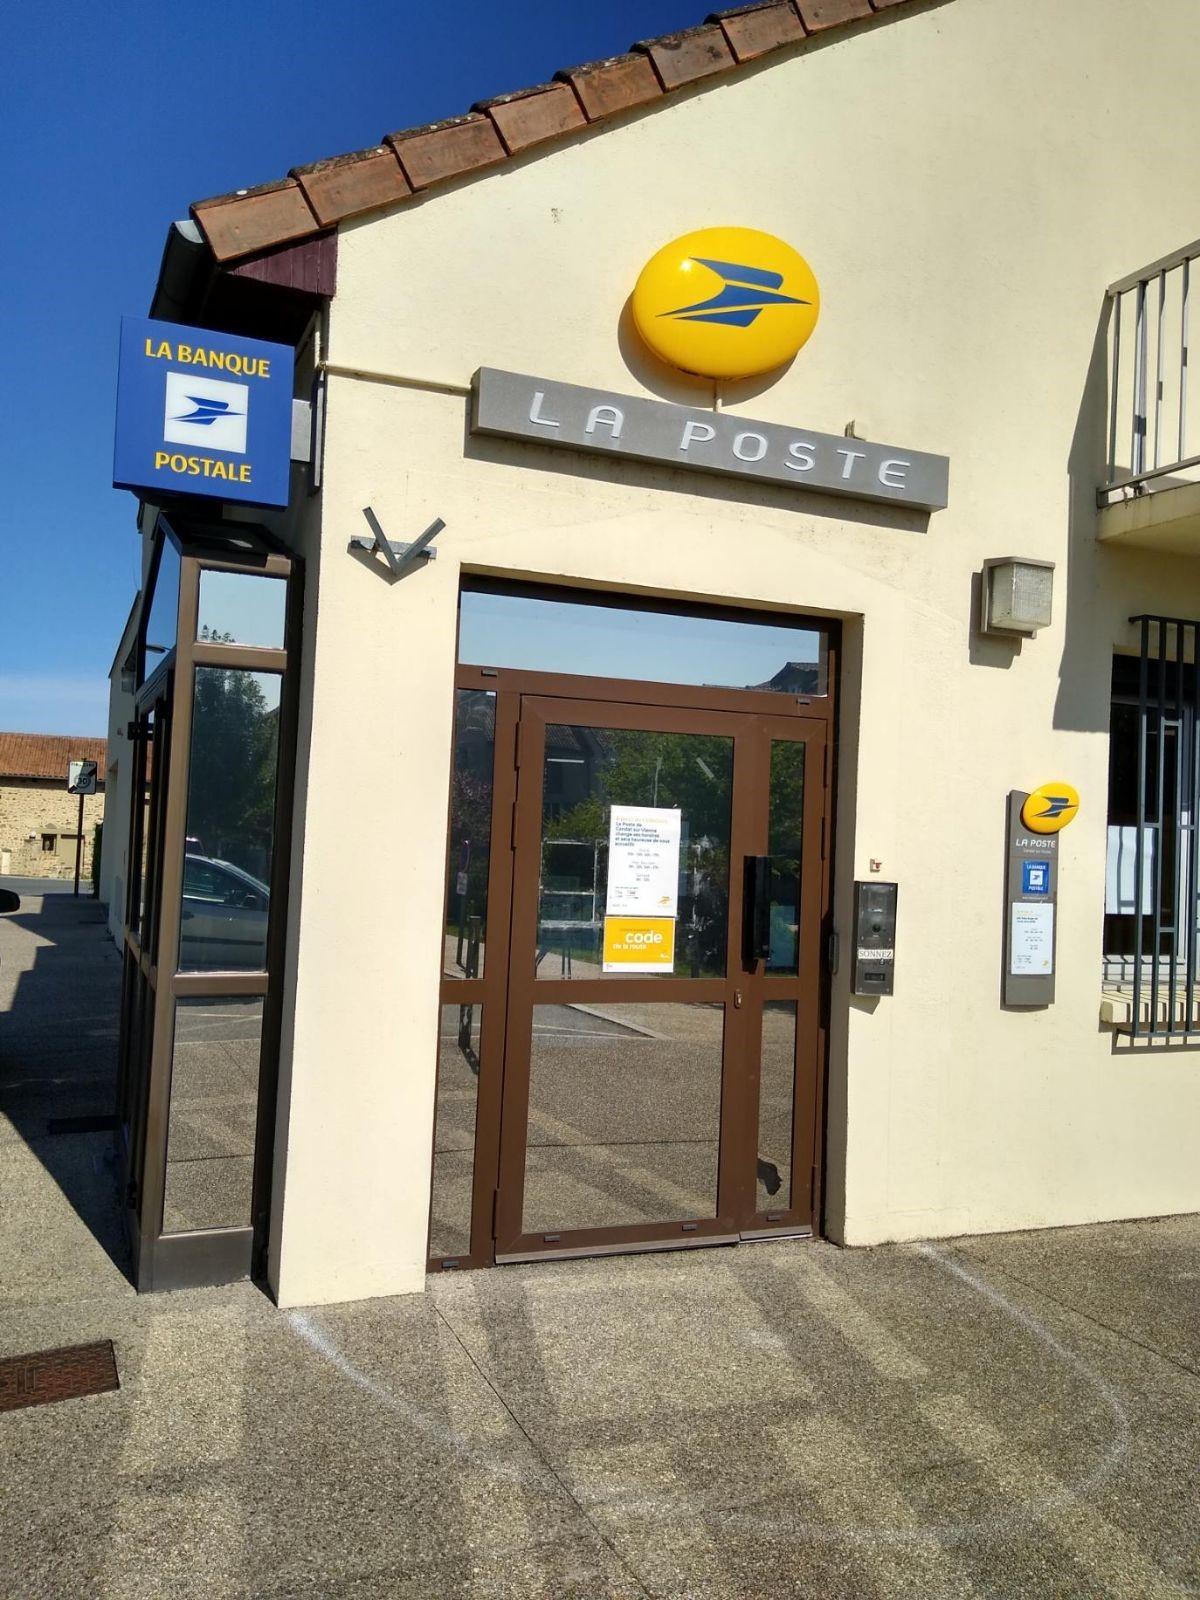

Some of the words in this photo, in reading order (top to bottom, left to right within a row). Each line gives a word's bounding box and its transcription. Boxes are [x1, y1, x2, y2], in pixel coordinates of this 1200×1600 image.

[145, 338, 172, 361] LA
[177, 344, 271, 378] BANQUE
[528, 391, 625, 439] LA
[680, 421, 912, 490] POSTE
[154, 451, 253, 483] POSTALE
[1015, 838, 1028, 847] LA
[1030, 839, 1056, 848] POSTE
[625, 930, 664, 944] code
[858, 950, 893, 958] SONNEZ
